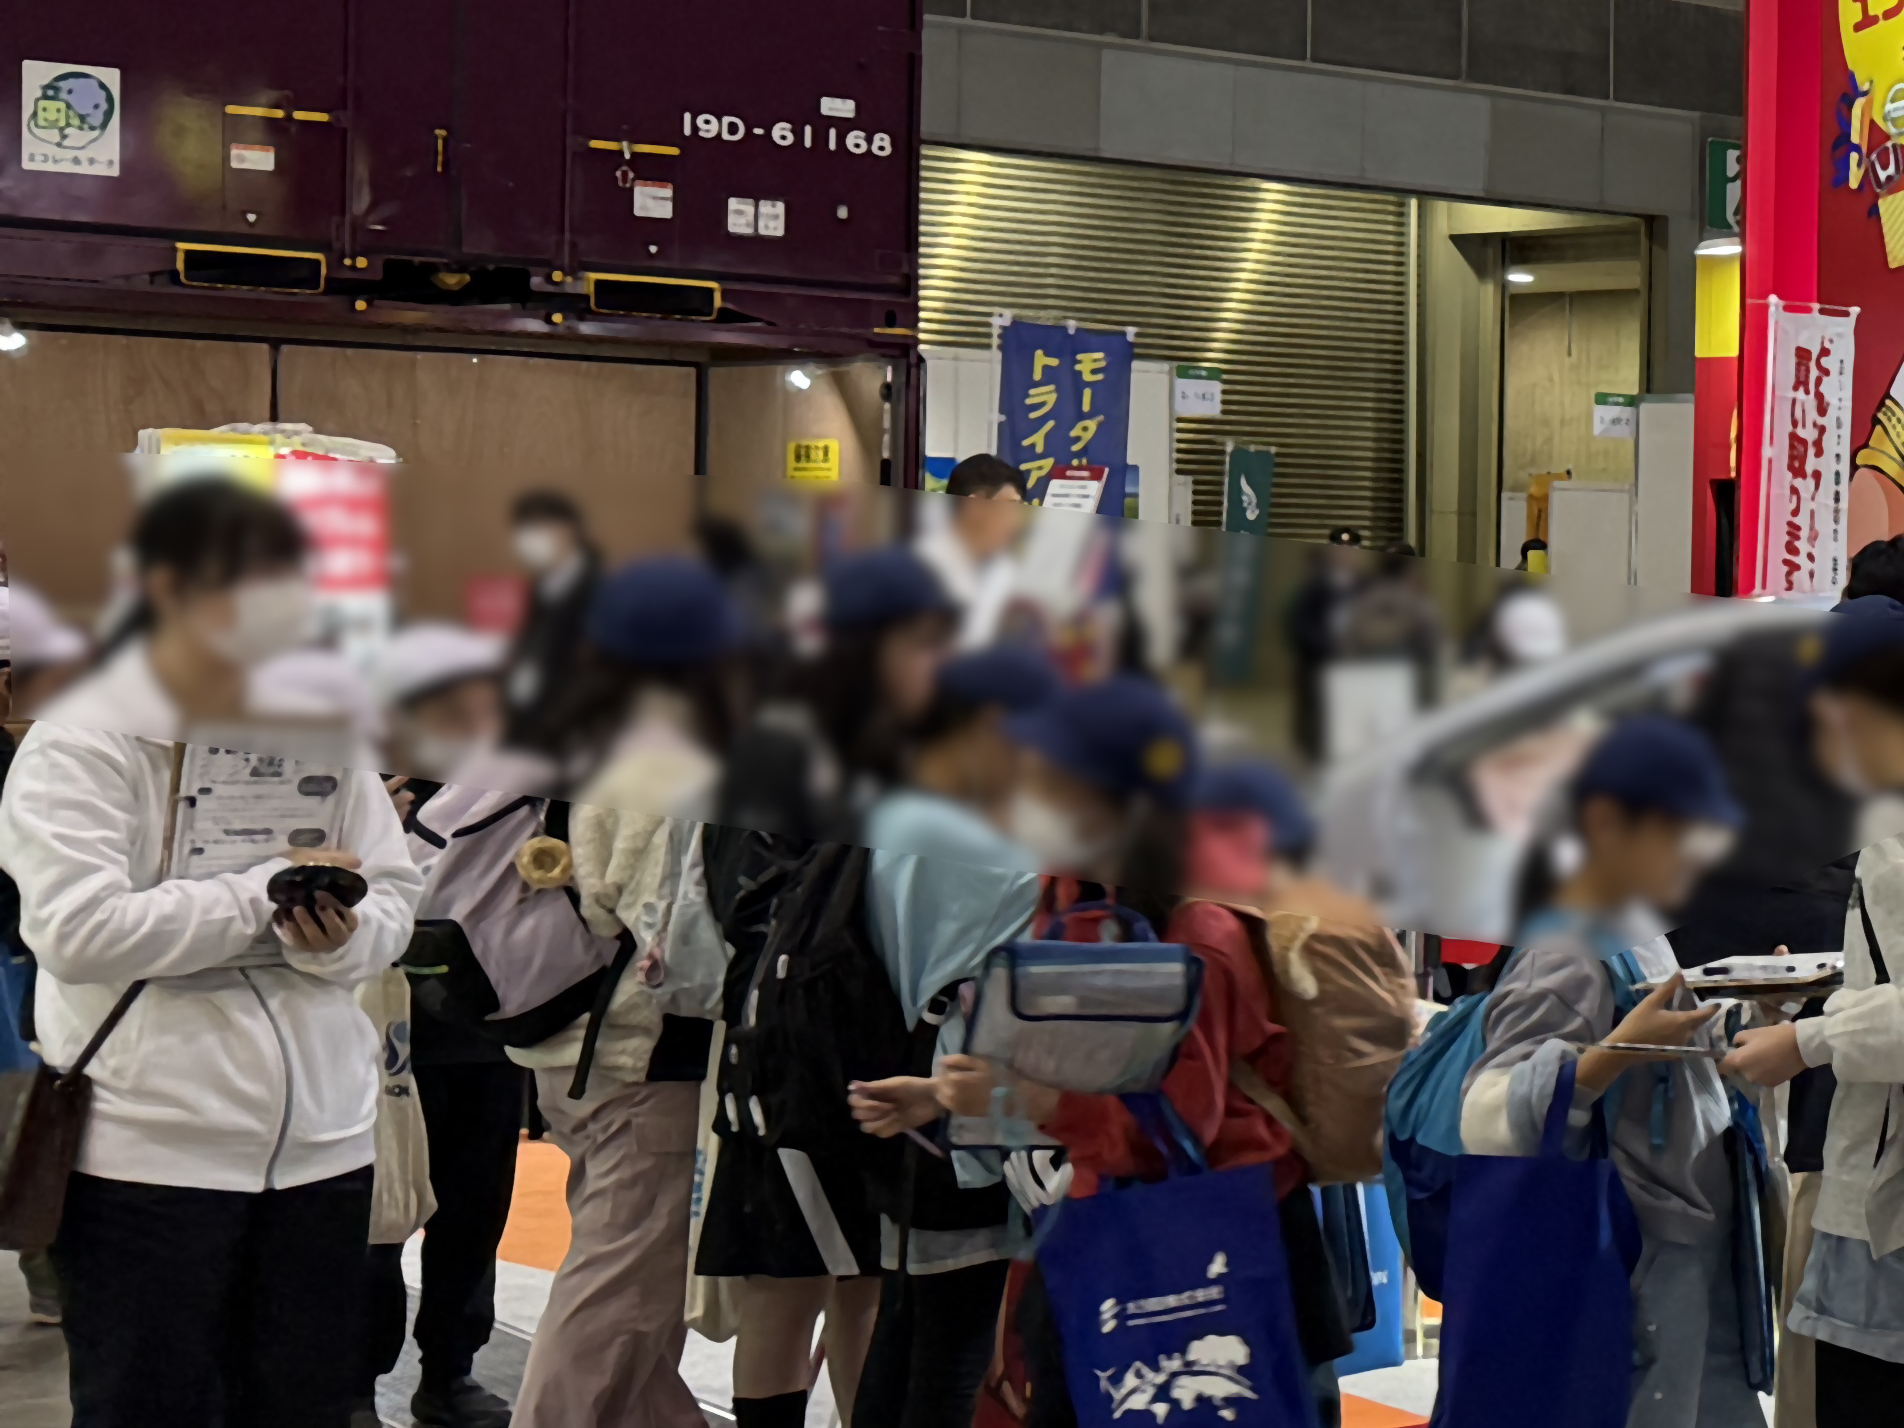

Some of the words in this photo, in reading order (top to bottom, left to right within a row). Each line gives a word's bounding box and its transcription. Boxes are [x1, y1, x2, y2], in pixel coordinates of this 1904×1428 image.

[683, 111, 892, 157] 19D-61168
[1018, 348, 1061, 507] トライア
[1068, 351, 1107, 467] モーダ
